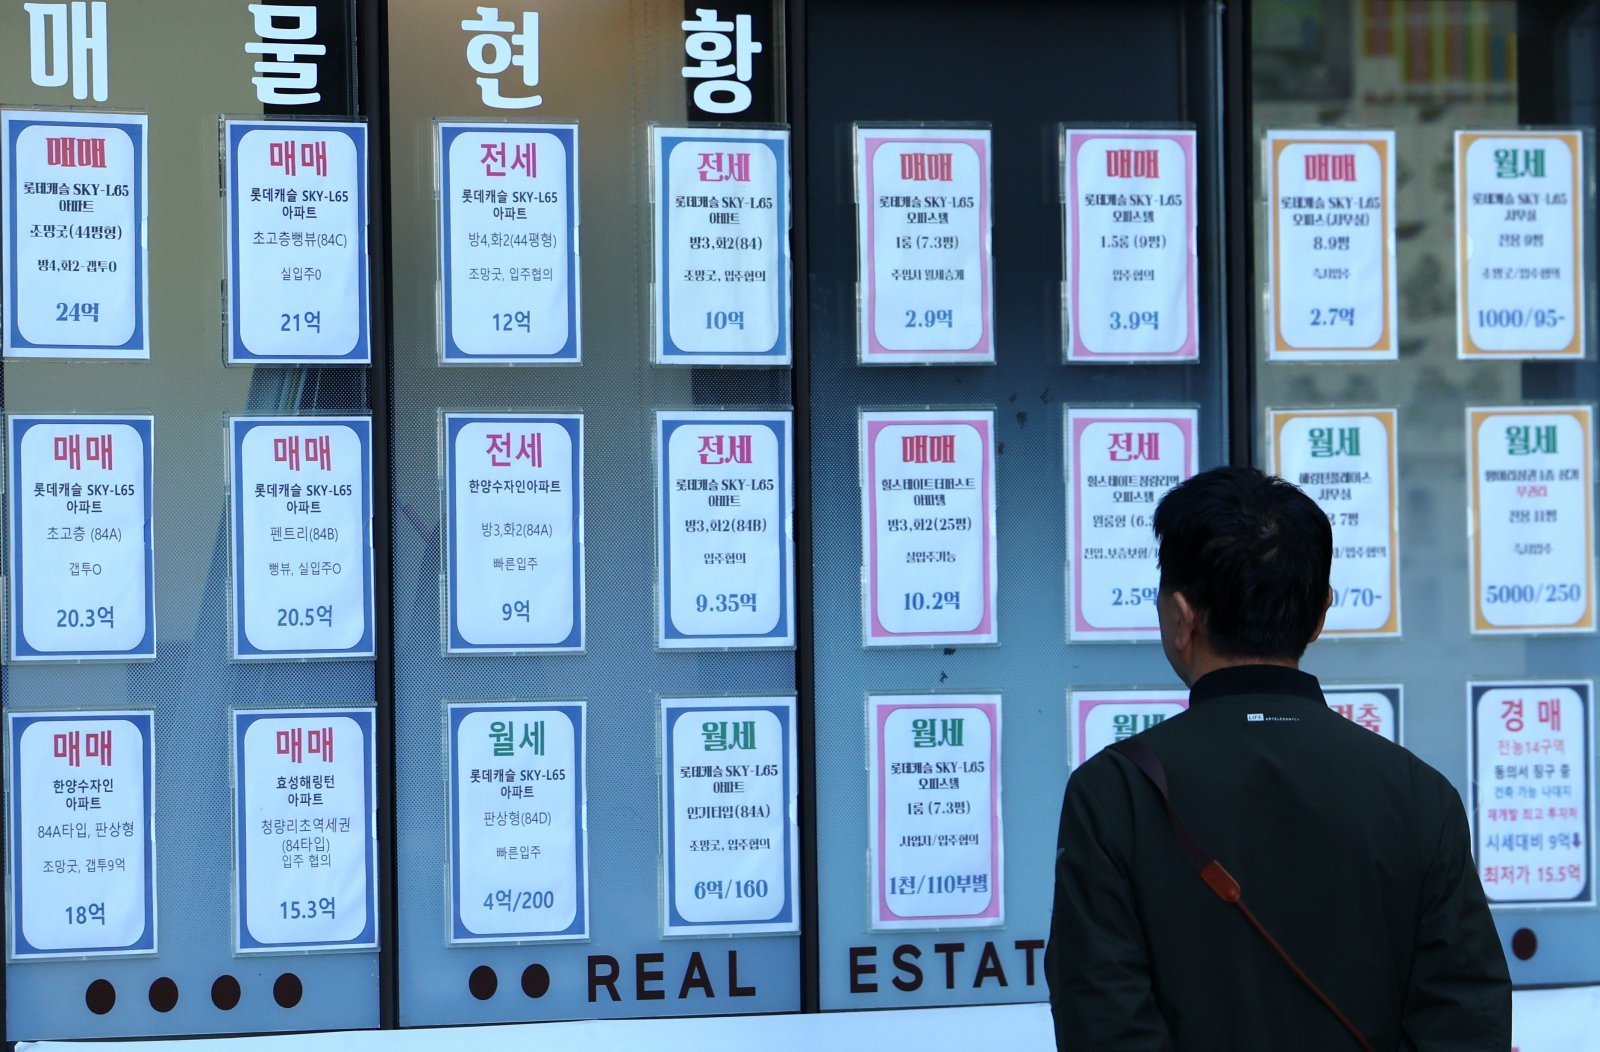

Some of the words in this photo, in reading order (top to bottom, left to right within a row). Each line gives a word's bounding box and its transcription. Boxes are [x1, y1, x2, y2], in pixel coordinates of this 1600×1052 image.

[46, 137, 106, 168] 매매
[270, 141, 327, 177] 매매
[480, 142, 536, 178] 전세
[697, 152, 751, 181] 전세
[900, 153, 952, 181] 매매
[1106, 150, 1158, 178] 매매
[1305, 154, 1356, 181] 매매
[1494, 149, 1545, 178] 월세
[24, 182, 69, 195] 롯데캐슬
[74, 184, 129, 196] SKY-L65
[250, 188, 297, 202] 롯데캐슬
[302, 190, 348, 202] SKY-L65
[462, 189, 508, 203] 롯데캐슬
[513, 192, 557, 203] SKY-L65
[59, 200, 94, 212] 아파트
[676, 196, 719, 208] 롯데캐슬
[722, 197, 772, 209] SKY-L65
[880, 196, 921, 208] 롯데캐슬
[924, 196, 974, 208] SKY-L65
[1085, 194, 1127, 206] 롯데캐슬
[1129, 194, 1182, 206] SKY-L65
[1328, 197, 1380, 209] SKY-L65
[1517, 193, 1567, 205] SKY-L65
[282, 206, 317, 220] 아파트
[493, 207, 527, 221] 아파트
[710, 213, 740, 224] 아파트
[907, 212, 949, 224] 오피스텔
[1113, 210, 1154, 223] 오피스텔
[30, 224, 122, 240] 조망굿(44평형)
[469, 232, 556, 248] 방4,화2(44평형)
[690, 236, 762, 250] 방3,화2(84)
[916, 235, 958, 249] (7.3평)
[1134, 235, 1166, 248] (9평)
[1313, 236, 1349, 250] 8.9평
[469, 268, 504, 281] 조망굿,
[510, 268, 552, 281] 입주협의
[725, 270, 766, 282] 입주협의
[1113, 269, 1154, 281] 입주협의
[56, 303, 99, 322] 24억
[905, 309, 952, 328] 2.9억
[1310, 308, 1355, 326] 2.7억
[1479, 309, 1565, 328] 1000/95-
[281, 311, 320, 333] 21억
[493, 311, 530, 333] 12억
[706, 311, 744, 330] 10억
[1110, 311, 1159, 330] 3.9억
[1108, 433, 1159, 461] 전세
[1309, 427, 1360, 458] 월세
[1506, 425, 1557, 456] 월세
[54, 434, 112, 470] 매매
[274, 435, 331, 471] 매매
[486, 432, 542, 468] 전세
[698, 435, 752, 464] 전세
[901, 435, 955, 463] 매매
[34, 483, 82, 497] 롯데캐슬
[87, 484, 134, 496] SKY-L65
[255, 483, 302, 497] 롯데캐슬
[307, 485, 352, 496] SKY-L65
[469, 479, 561, 494] 한양수자인아파트
[677, 479, 718, 491] 롯데캐슬
[722, 479, 774, 490] SKY-L65
[708, 495, 741, 506] 아파트
[914, 494, 946, 506] 아파텔
[1113, 491, 1154, 503] 오피스텔
[67, 500, 102, 514] 아파트
[287, 500, 321, 514] 아파트
[482, 522, 552, 538] 방3,화2(84A)
[685, 518, 766, 533] 방3,화2(84B)
[888, 517, 971, 531] 방3,화2(25평)
[47, 526, 85, 541] 초고층
[91, 528, 121, 542] (84A)
[270, 526, 338, 542] 펜트리(84B)
[493, 557, 538, 571] 빠른입주
[704, 553, 746, 564] 입주협의
[907, 551, 956, 563] 실입주가능
[905, 591, 960, 610] 10.2억
[1112, 588, 1157, 607] 2.5억
[1486, 583, 1581, 604] 5000/250
[696, 593, 756, 612] 9.35억
[57, 606, 113, 629] 20.3억
[278, 605, 332, 627] 20.5억
[502, 600, 529, 622] 9억
[489, 721, 544, 756] 월세
[702, 721, 756, 751] 월세
[912, 718, 964, 748] 월세
[54, 730, 111, 767] 매매
[276, 727, 333, 765] 매매
[680, 766, 722, 778] 롯데캐슬
[726, 765, 778, 777] SKY-L65
[891, 762, 932, 774] 롯데캐슬
[936, 761, 984, 773] SKY-L65
[276, 775, 334, 790] 효성해링턴
[470, 769, 516, 783] 롯데캐슬
[520, 769, 565, 781] SKY-L65
[919, 778, 959, 789] 오피스텔
[53, 778, 113, 793] 한양수자인
[501, 785, 534, 799] 아파트
[713, 781, 744, 793] 아파트
[66, 796, 101, 811] 아파트
[288, 793, 323, 807] 아파트
[687, 804, 770, 819] 인기타입(84A)
[928, 801, 970, 815] (7.3평)
[262, 817, 350, 835] 청량리초역세권
[484, 811, 551, 827] 판상형(84D)
[38, 823, 90, 839] 84A타입,
[96, 821, 133, 837] 판상형
[282, 837, 329, 854] (84타입)
[728, 838, 770, 850] 입주협의
[900, 834, 978, 847] 사업자/입주협의
[282, 855, 304, 868] 입주
[308, 853, 331, 868] 협의
[496, 846, 541, 860] 빠른입주
[43, 860, 80, 873] 조망굿,
[86, 858, 125, 872] 갭투9억
[1484, 867, 1531, 884] 최저가
[1538, 865, 1581, 883] 15.5억
[694, 880, 768, 899] 6억/160
[280, 897, 335, 919] 15.3억
[483, 889, 554, 912] 4억/200
[66, 902, 105, 925] 18억
[587, 950, 757, 1002] REAL
[849, 939, 1046, 995] ESTAT
